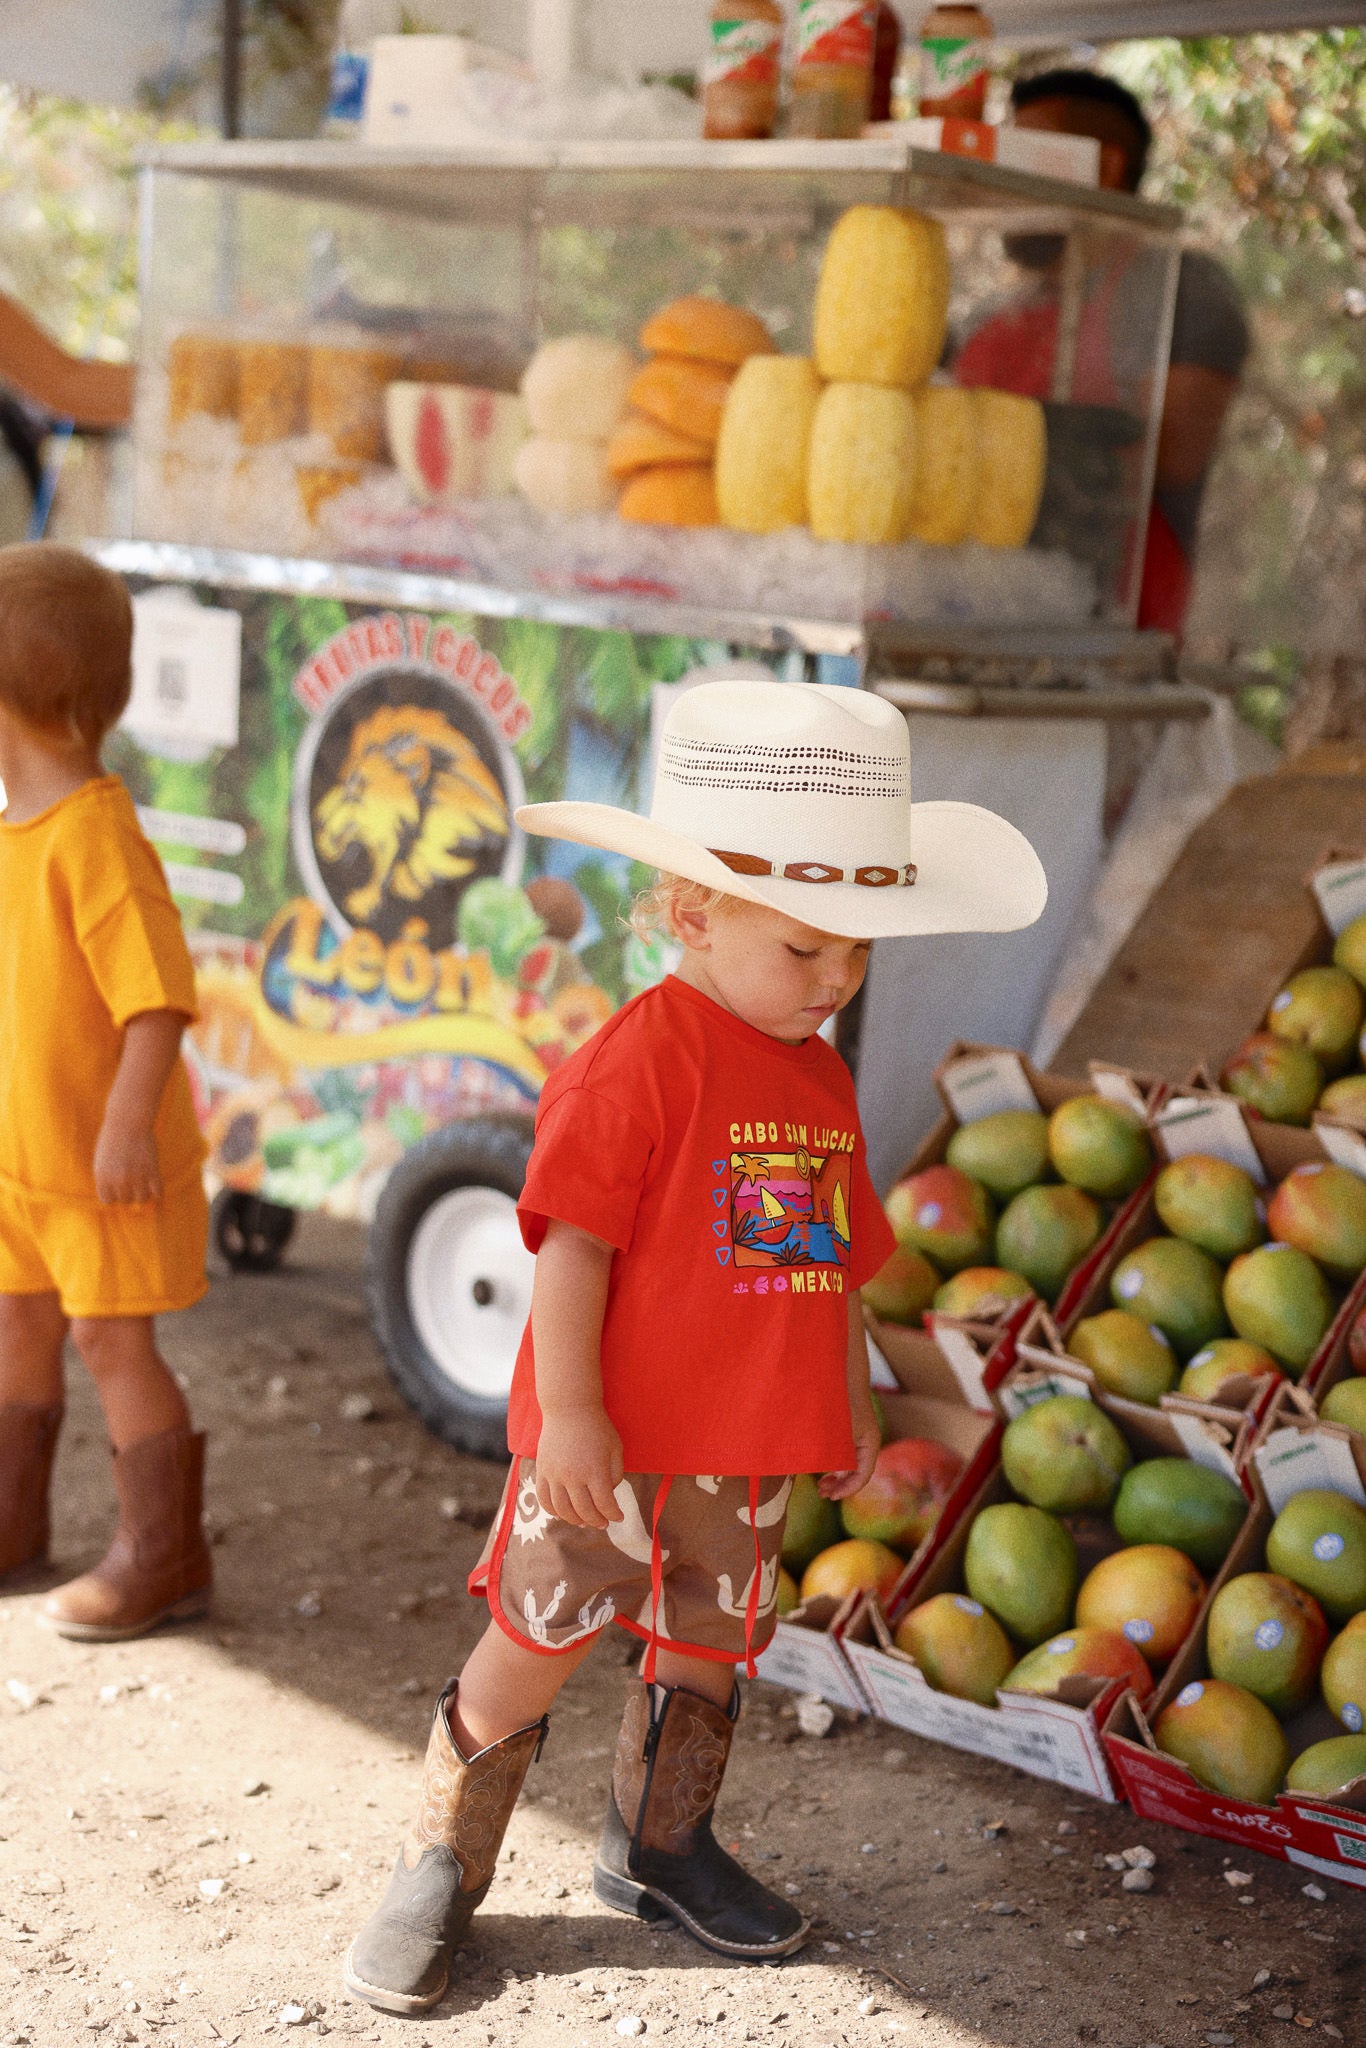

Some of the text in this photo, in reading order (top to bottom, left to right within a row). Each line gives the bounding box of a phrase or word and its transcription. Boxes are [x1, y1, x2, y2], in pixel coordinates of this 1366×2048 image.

[729, 1121, 856, 1153] CABO SAN LUCAS
